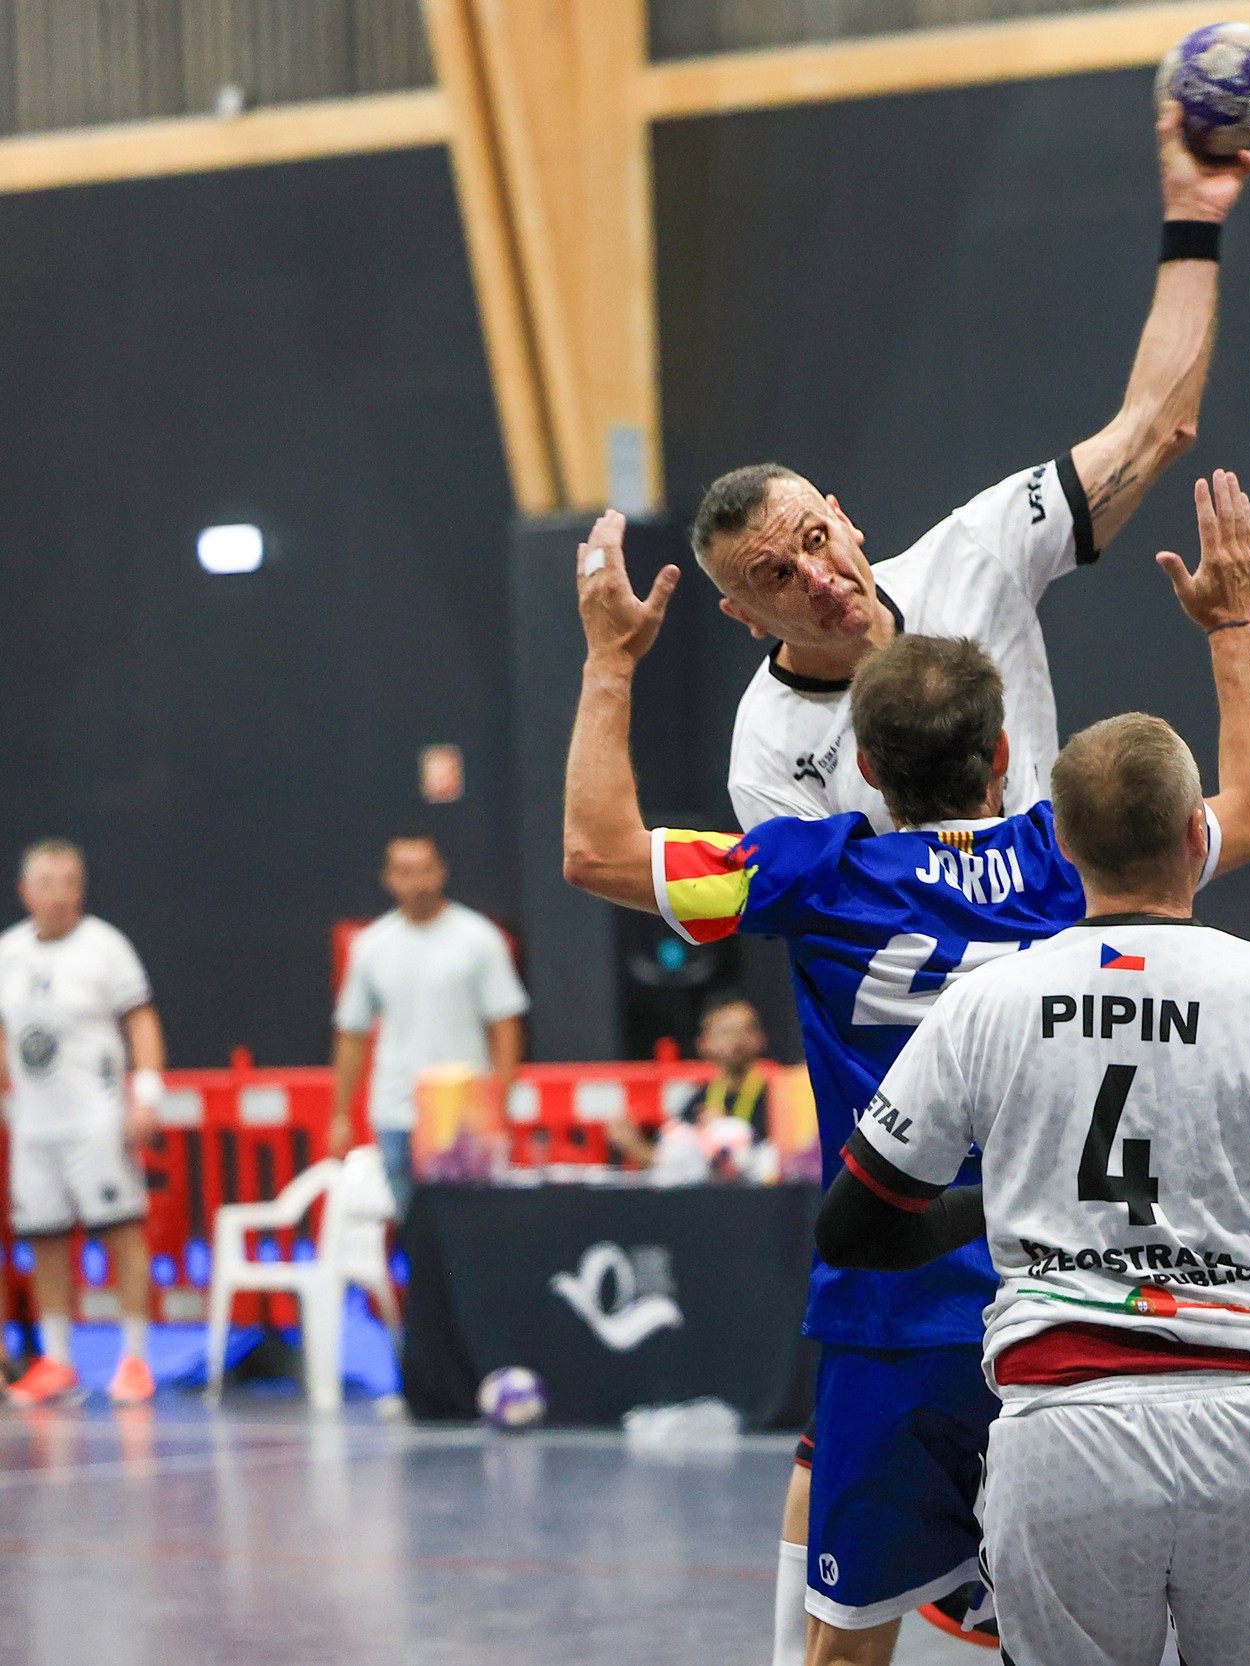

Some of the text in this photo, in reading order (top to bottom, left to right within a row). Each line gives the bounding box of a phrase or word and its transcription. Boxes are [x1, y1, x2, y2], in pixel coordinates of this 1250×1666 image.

[915, 845, 1025, 904] JORDI
[1042, 994, 1200, 1045] PIPIN
[1077, 1064, 1159, 1226] 4
